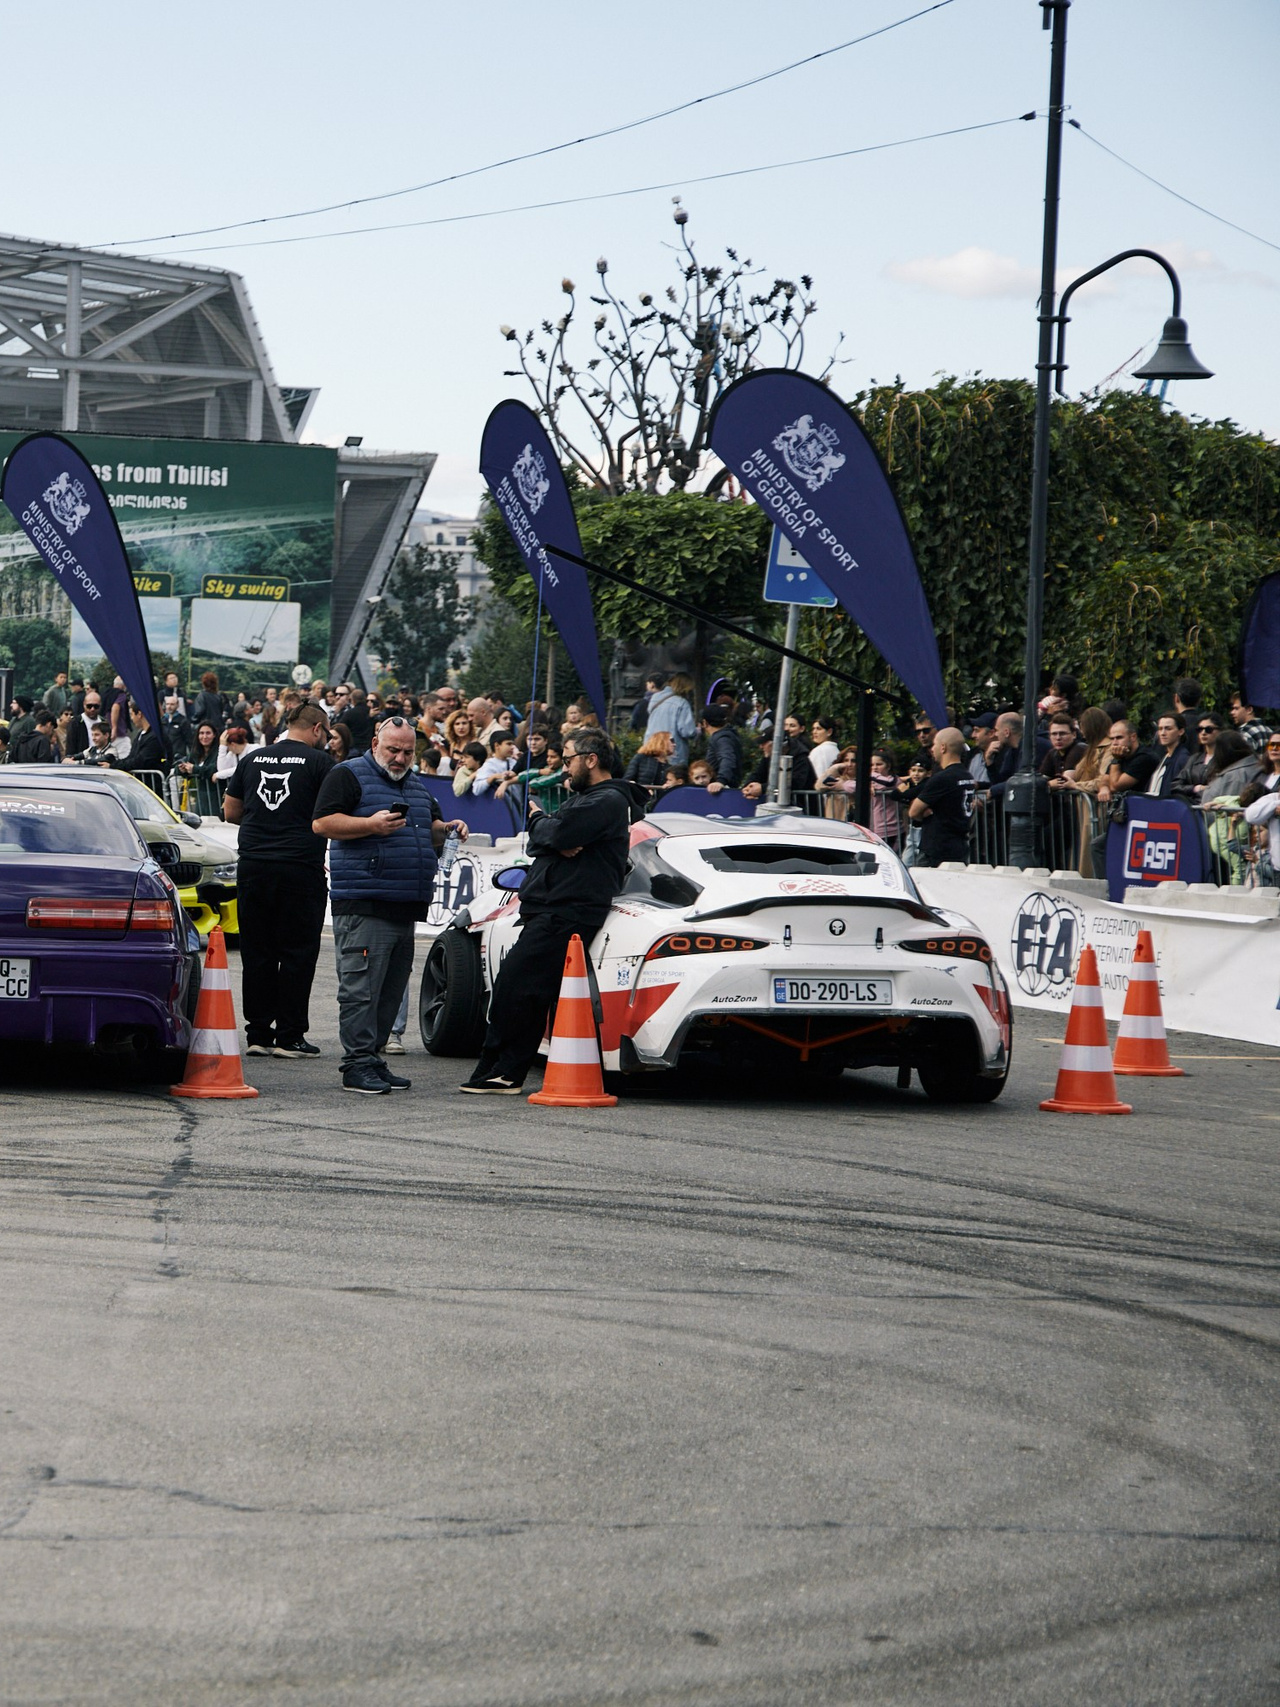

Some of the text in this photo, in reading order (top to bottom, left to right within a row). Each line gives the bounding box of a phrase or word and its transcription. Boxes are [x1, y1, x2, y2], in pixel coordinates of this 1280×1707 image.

[117, 463, 162, 484] from
[167, 465, 228, 487] Tbilisi
[108, 494, 187, 510] ბილისიდან
[741, 460, 807, 539] OF GEORGIA
[751, 448, 859, 572] MINISTRY OF SPORT
[496, 487, 532, 558] OF GEORGIA
[500, 476, 560, 588] MINISTRY OF SPORT
[21, 510, 65, 574] OF GEORGIA
[28, 500, 101, 601] MINISTRY OF SPORT
[205, 579, 285, 600] Sky swing
[253, 756, 306, 765] ALPHA GREEN
[1130, 832, 1177, 870] GASF
[711, 995, 758, 1003] AutoZona
[776, 981, 877, 1002] GE DO-290-LS
[910, 998, 953, 1006] AutoZona
